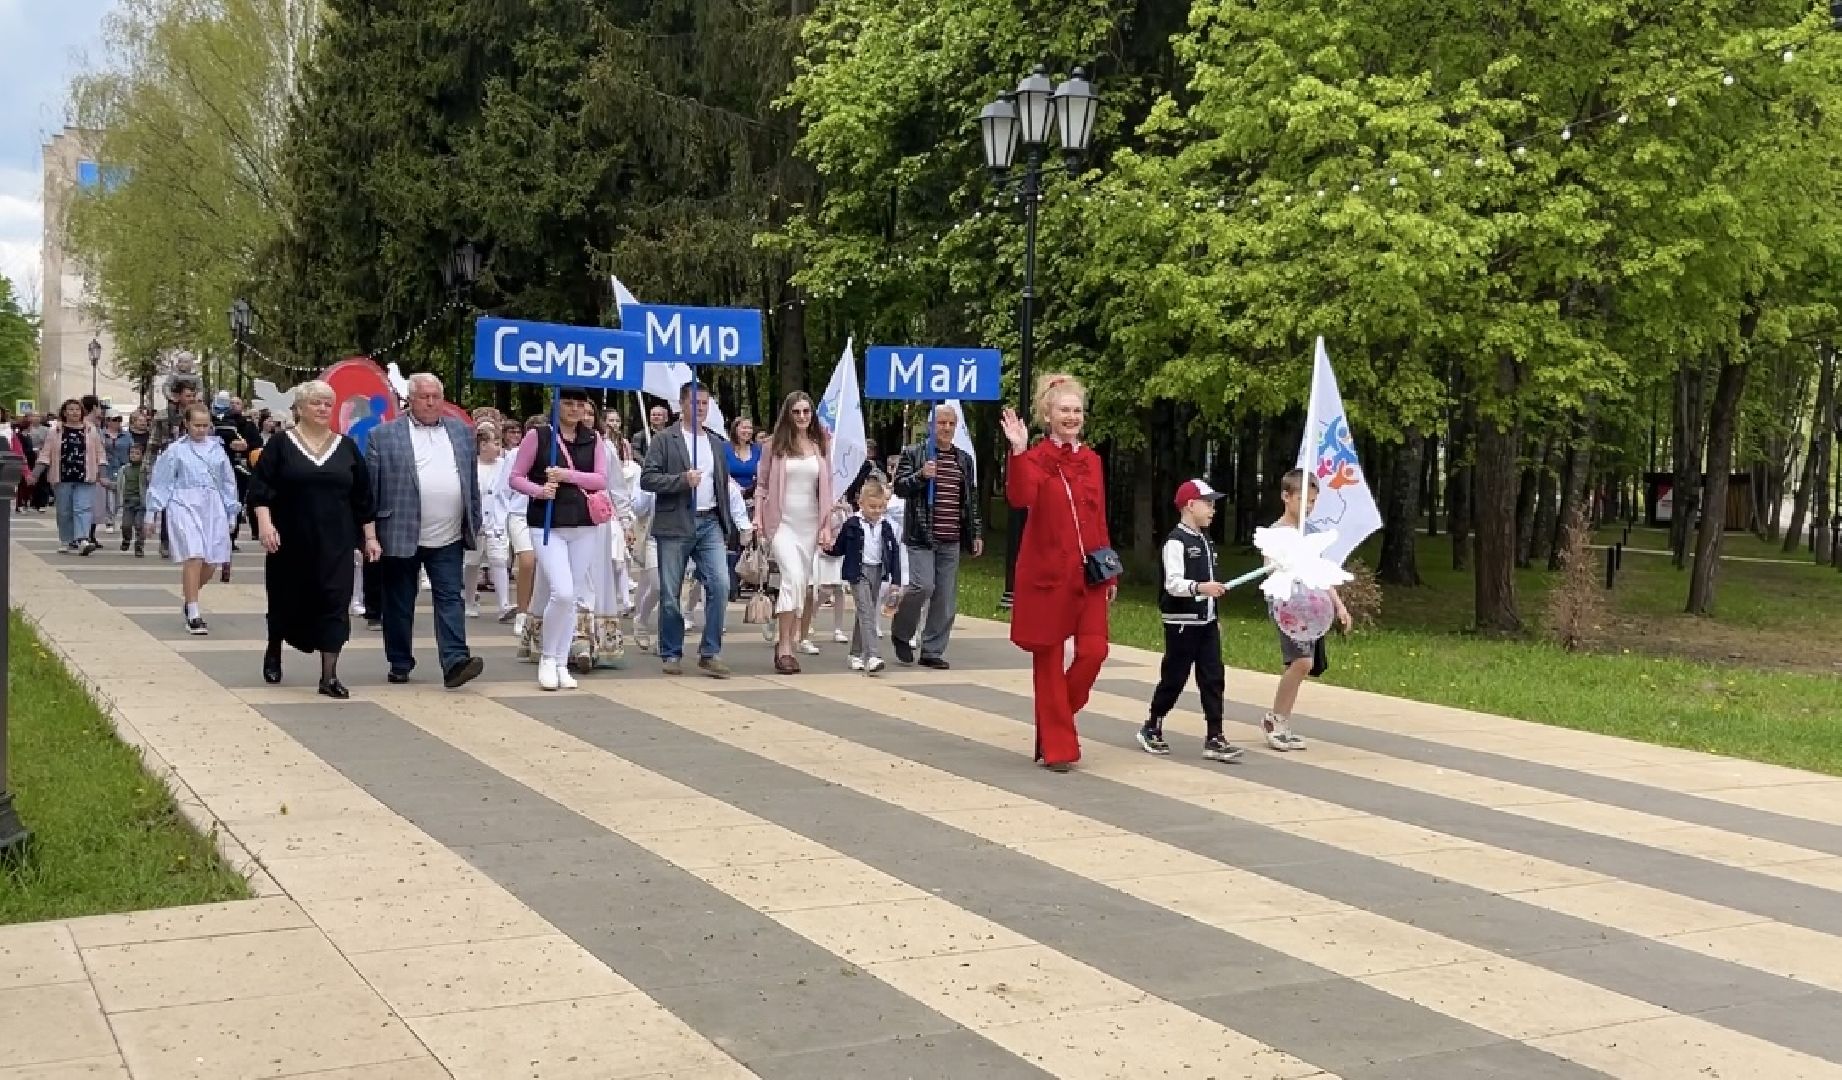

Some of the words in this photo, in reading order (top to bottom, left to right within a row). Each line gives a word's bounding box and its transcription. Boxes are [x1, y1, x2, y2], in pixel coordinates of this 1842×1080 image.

[493, 326, 624, 381] Семья
[645, 311, 740, 362] Мир
[889, 352, 978, 394] Май
